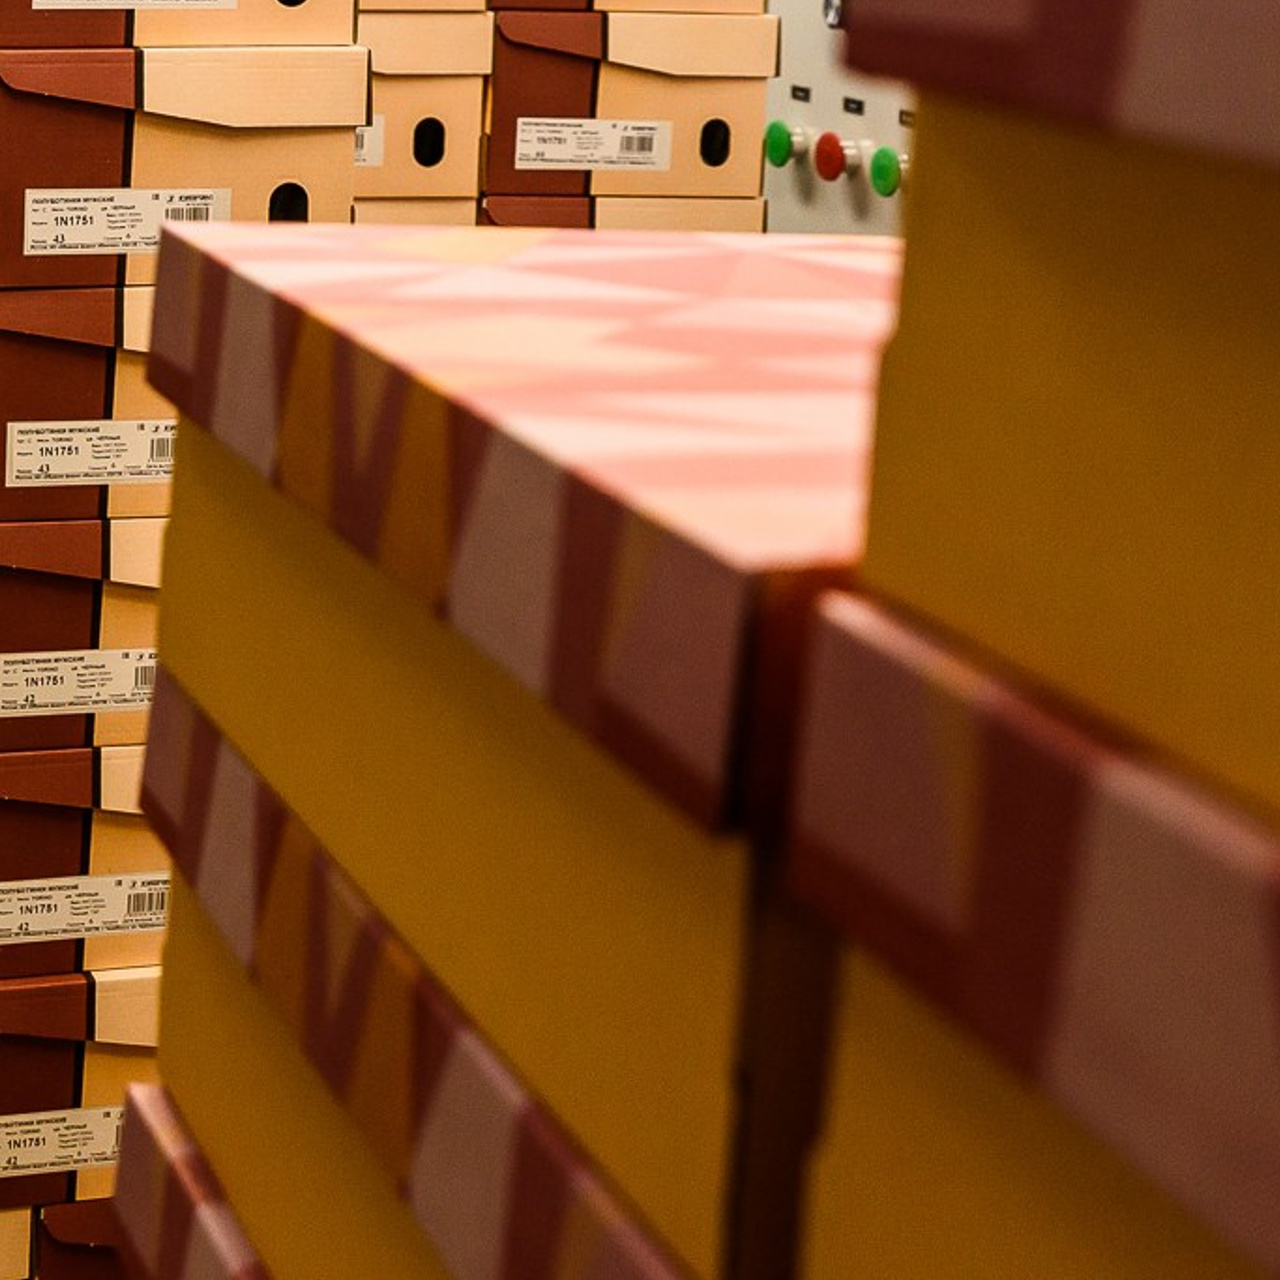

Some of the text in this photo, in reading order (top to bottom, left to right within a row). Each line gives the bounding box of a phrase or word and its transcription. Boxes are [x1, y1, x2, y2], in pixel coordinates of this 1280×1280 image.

[53, 215, 94, 226] 1N1751
[52, 233, 65, 244] 43
[38, 445, 79, 456] 1N1751
[37, 463, 50, 473] 43
[24, 675, 64, 687] 1N1751
[23, 693, 35, 703] 42
[18, 902, 58, 915] 1N1751
[17, 921, 29, 931] 42
[7, 1136, 46, 1149] 1N1751
[5, 1155, 18, 1165] 42
